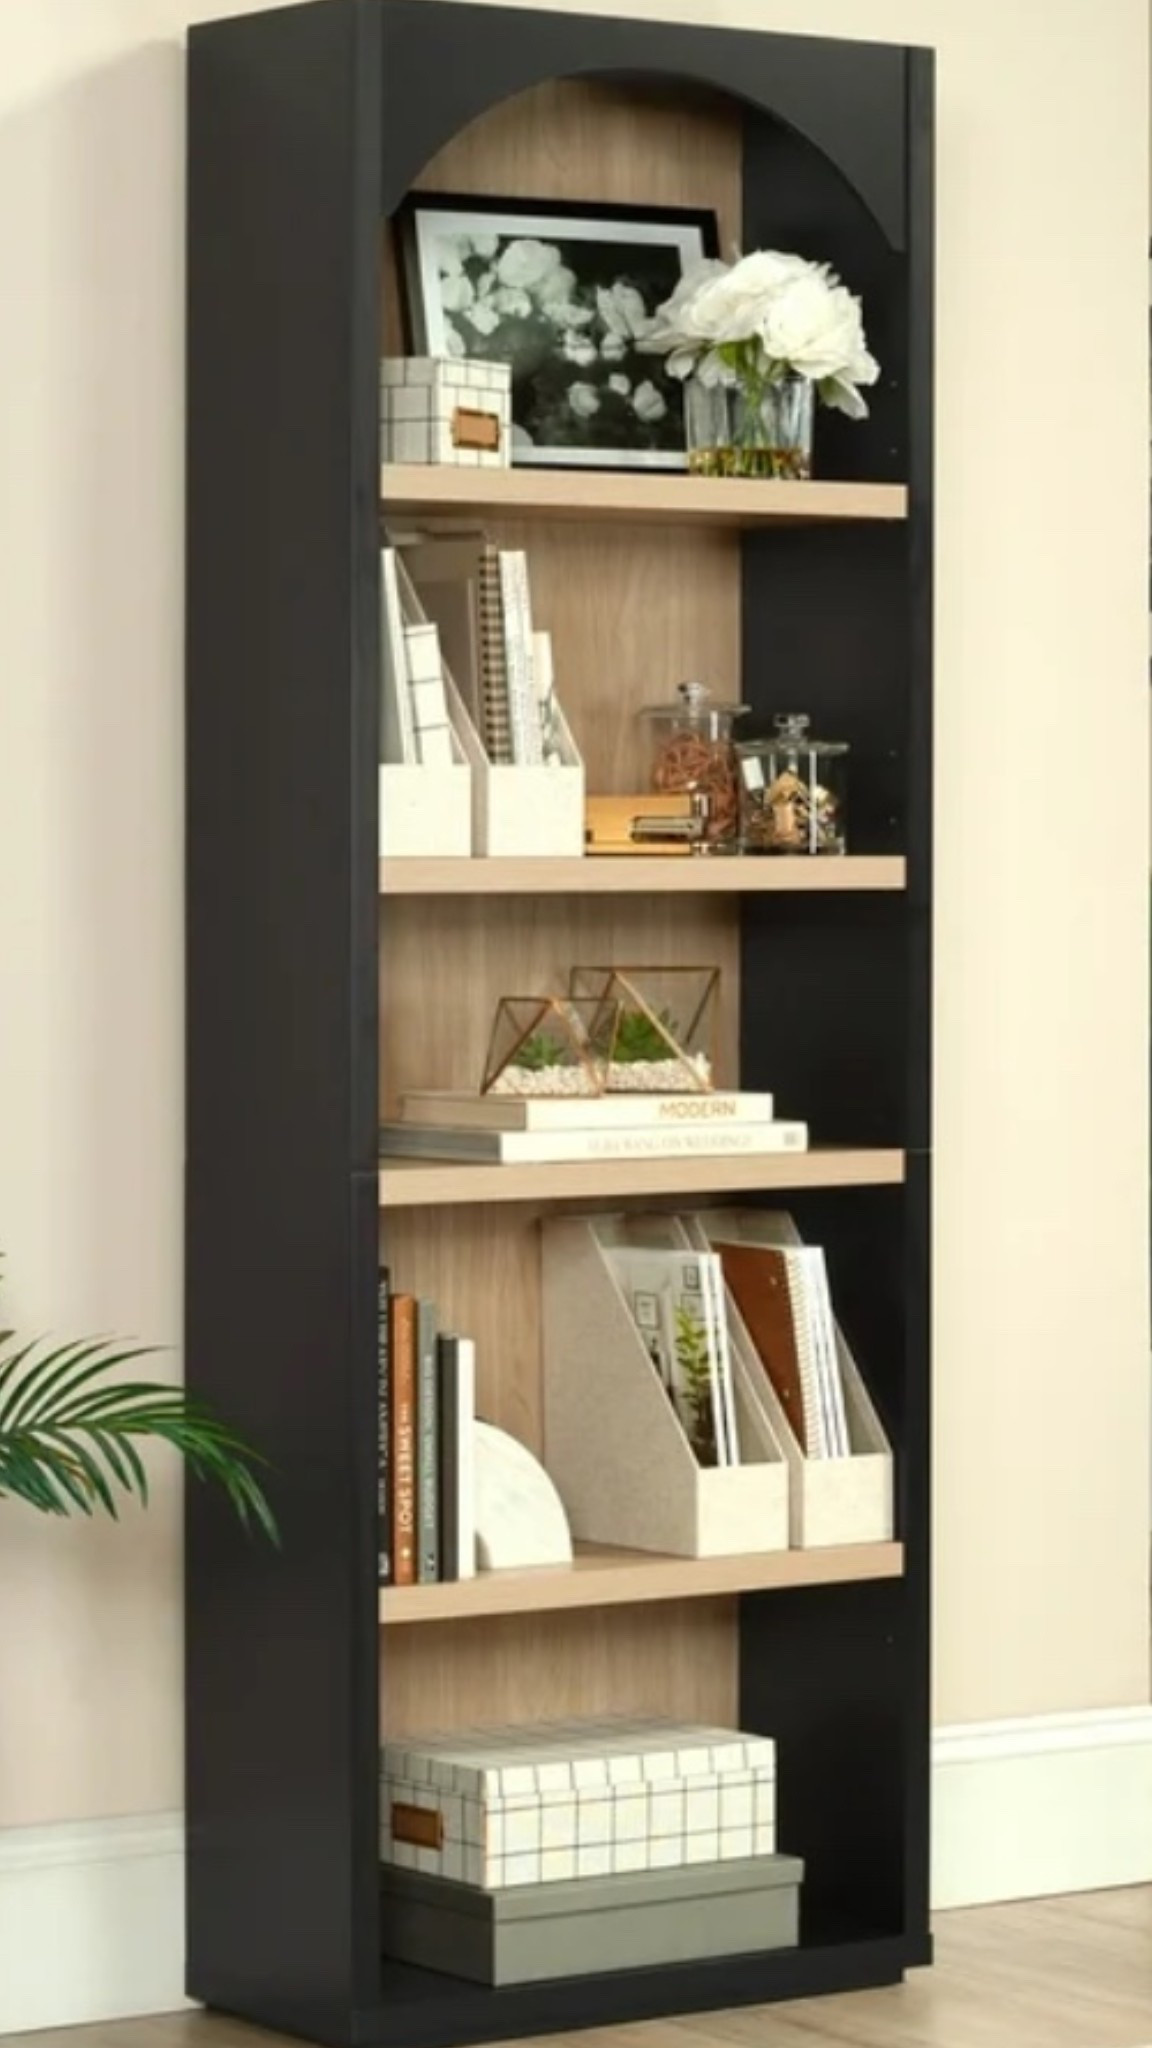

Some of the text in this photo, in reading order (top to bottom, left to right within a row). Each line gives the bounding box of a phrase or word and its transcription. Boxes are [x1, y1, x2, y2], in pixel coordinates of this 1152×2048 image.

[660, 1101, 736, 1119] MODERN
[397, 1425, 413, 1485] SWEET
[397, 1487, 413, 1533] SPOT
